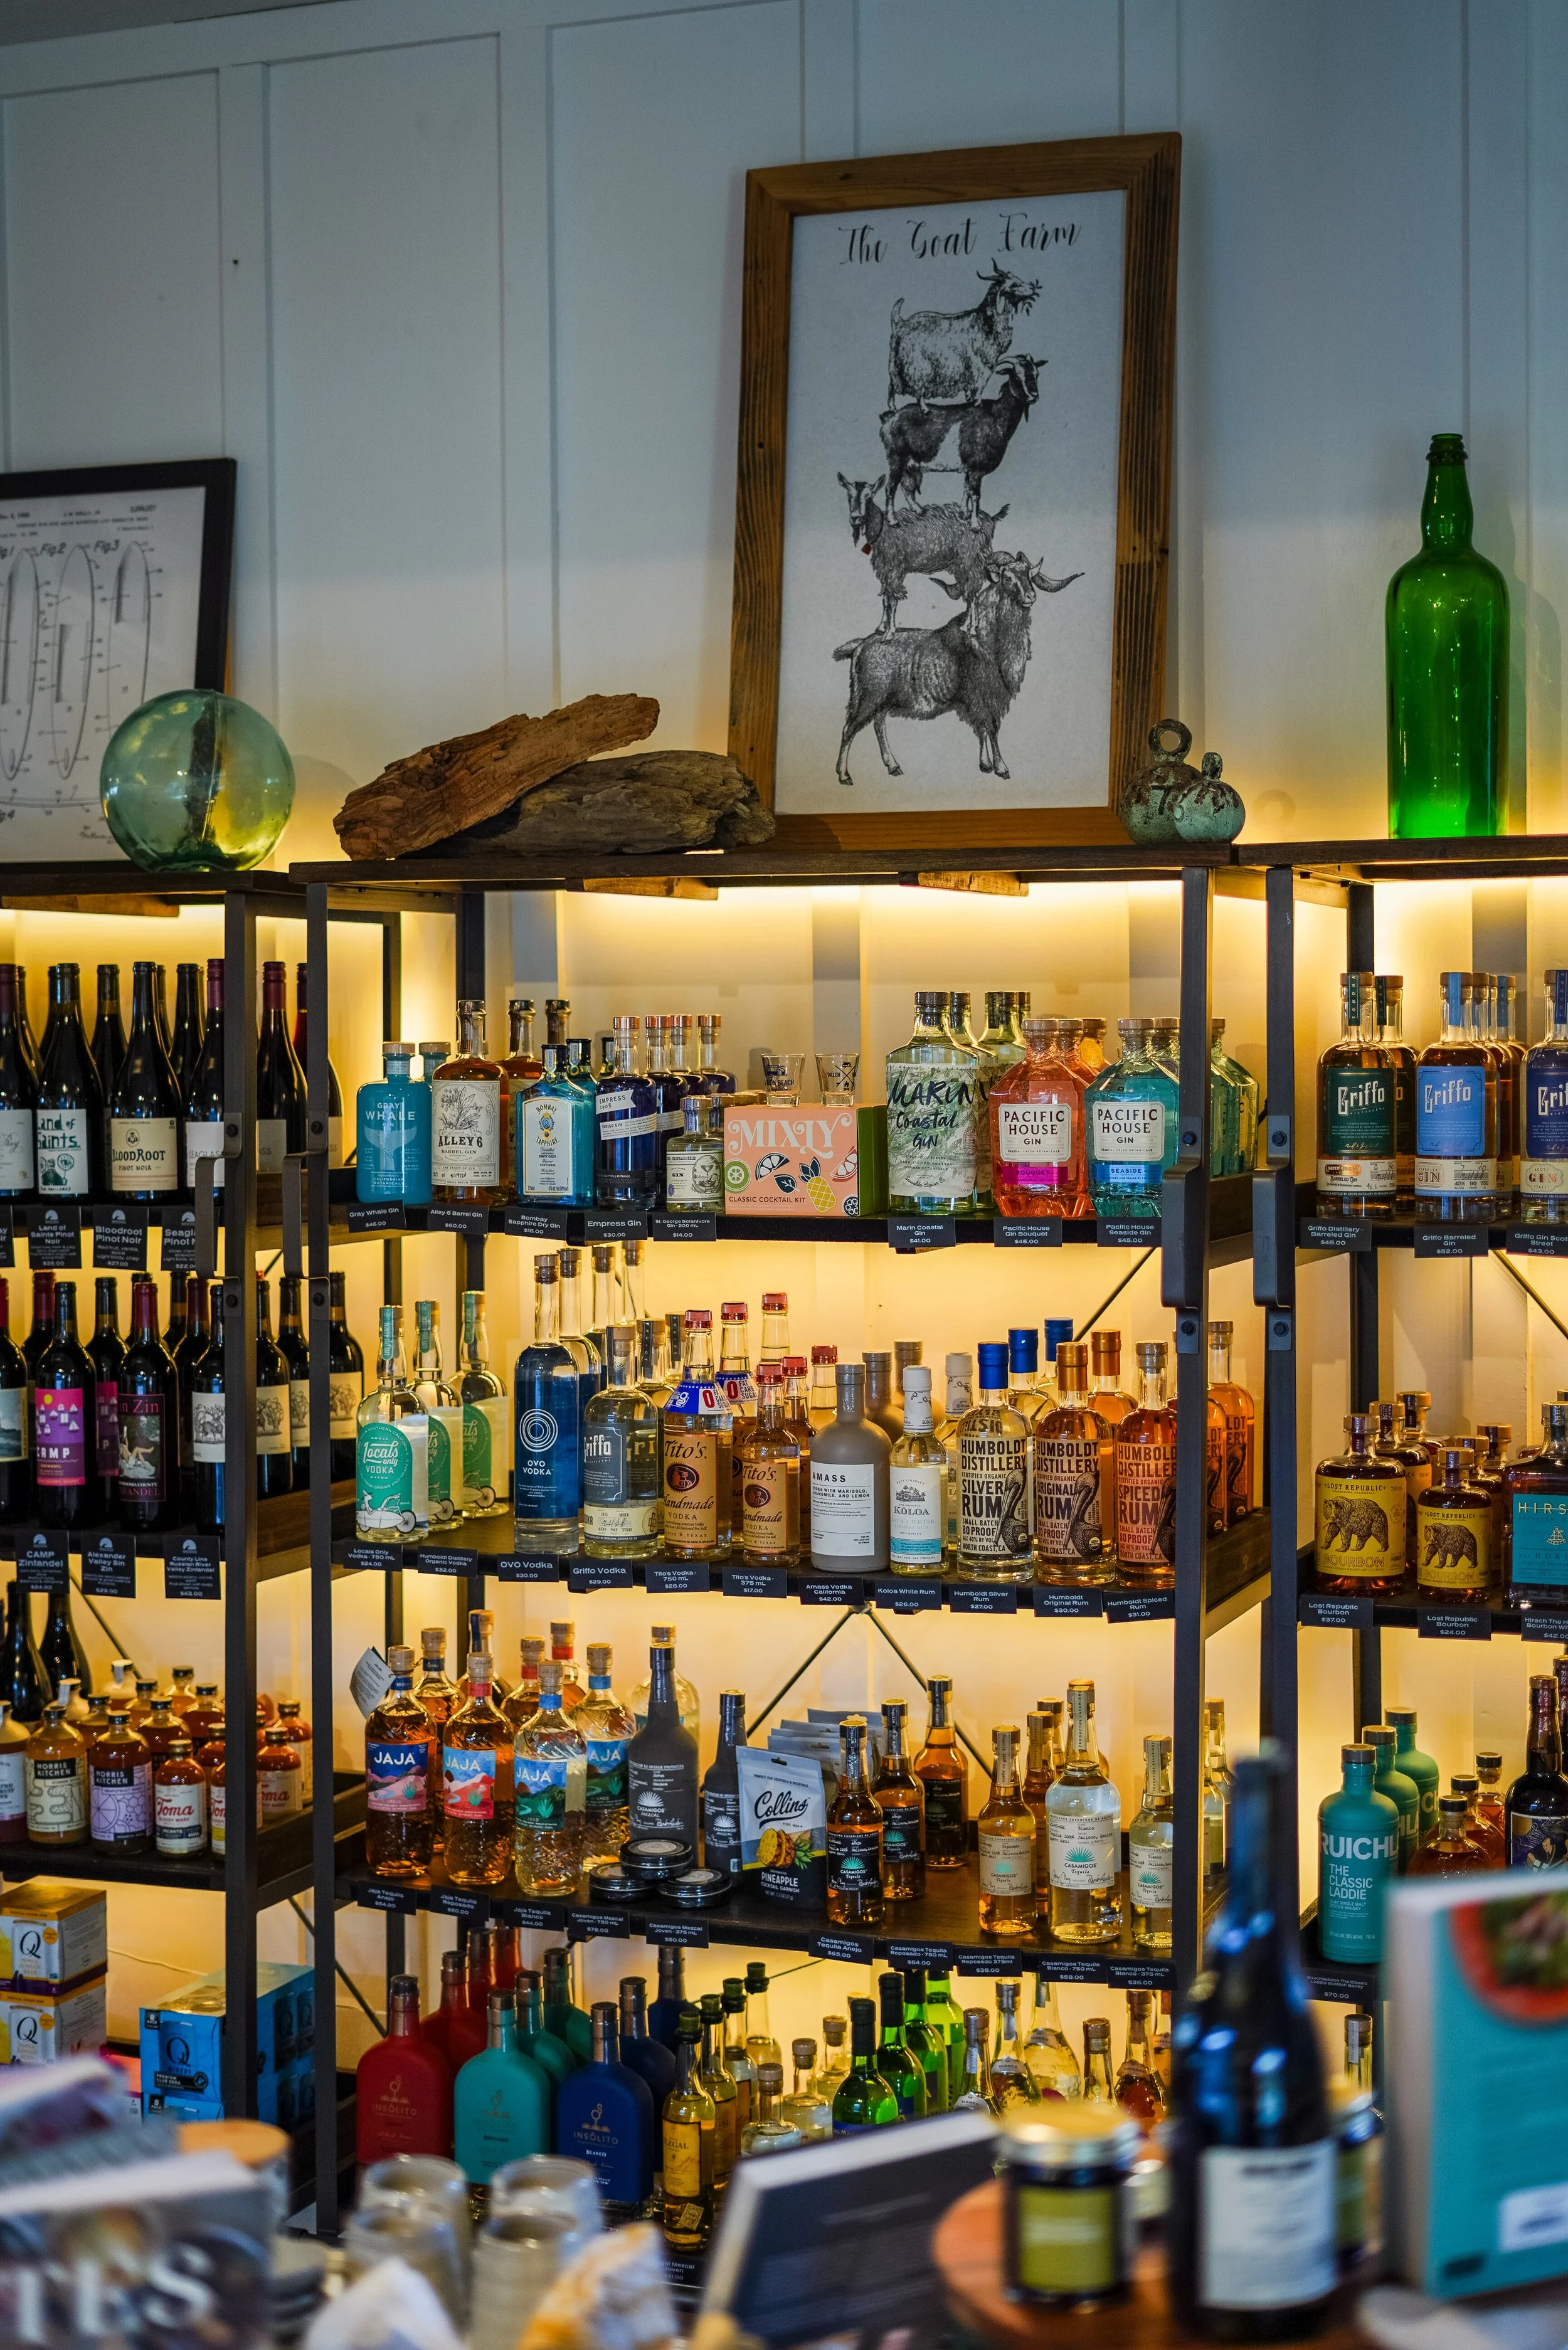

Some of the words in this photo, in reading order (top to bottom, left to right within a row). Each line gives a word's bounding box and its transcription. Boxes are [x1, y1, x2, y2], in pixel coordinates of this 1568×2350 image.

[839, 225, 887, 264] The
[907, 218, 977, 258] Goat
[998, 212, 1082, 252] Farm
[599, 1095, 626, 1104] EMPRESS
[1338, 1080, 1385, 1116] Griffo
[1424, 1079, 1472, 1114] Griffo
[536, 1104, 558, 1113] BOMBAY
[1098, 1109, 1157, 1121] PACIFIC
[366, 1111, 415, 1121] WHALE
[896, 1111, 958, 1129] Coastal
[1004, 1111, 1064, 1122] PACIFIC
[1009, 1125, 1058, 1135] HOUSE
[1101, 1123, 1150, 1133] HOUSE
[438, 1136, 474, 1147] ALLEY
[476, 1136, 483, 1147] 6
[534, 1136, 559, 1146] SAPPHIRE
[728, 1113, 852, 1158] MIXLY
[1418, 1172, 1441, 1183] GIN
[508, 1219, 534, 1227] Sapphire
[521, 1215, 548, 1223] Bombay
[95, 1227, 142, 1237] Bloodroot
[96, 1234, 118, 1244] Pinot
[120, 1236, 142, 1245] Noir
[726, 1380, 737, 1399] 0
[134, 1399, 160, 1413] Zin
[363, 1441, 399, 1463] Locals
[664, 1439, 707, 1459] Tito's
[961, 1439, 1026, 1454] HUMBOLDT
[383, 1458, 398, 1466] only
[961, 1455, 1027, 1471] DISTILLERY
[366, 1465, 395, 1474] VODKA
[743, 1465, 777, 1481] Tito's
[812, 1474, 845, 1482] AMASS
[962, 1479, 1004, 1494] SILVER
[962, 1495, 1002, 1517] RUM
[669, 1512, 697, 1520] VODKA
[962, 1527, 969, 1535] 80
[970, 1527, 995, 1536] PROOF
[19, 1559, 65, 1567] Zinfandel
[373, 1752, 415, 1765] JAJA
[445, 1756, 481, 1772] JAJA
[157, 1798, 194, 1816] Toma
[754, 1791, 809, 1829] Collins
[1329, 1863, 1349, 1876] THE
[761, 1872, 798, 1888] PINEAPPLE
[1329, 1875, 1373, 1888] CLASSIC
[1329, 1887, 1366, 1900] LADDIE
[19, 1930, 41, 1959] Q
[817, 1942, 843, 1950] Tequila
[821, 1937, 859, 1947] Casamigos
[167, 2036, 191, 2067] Q
